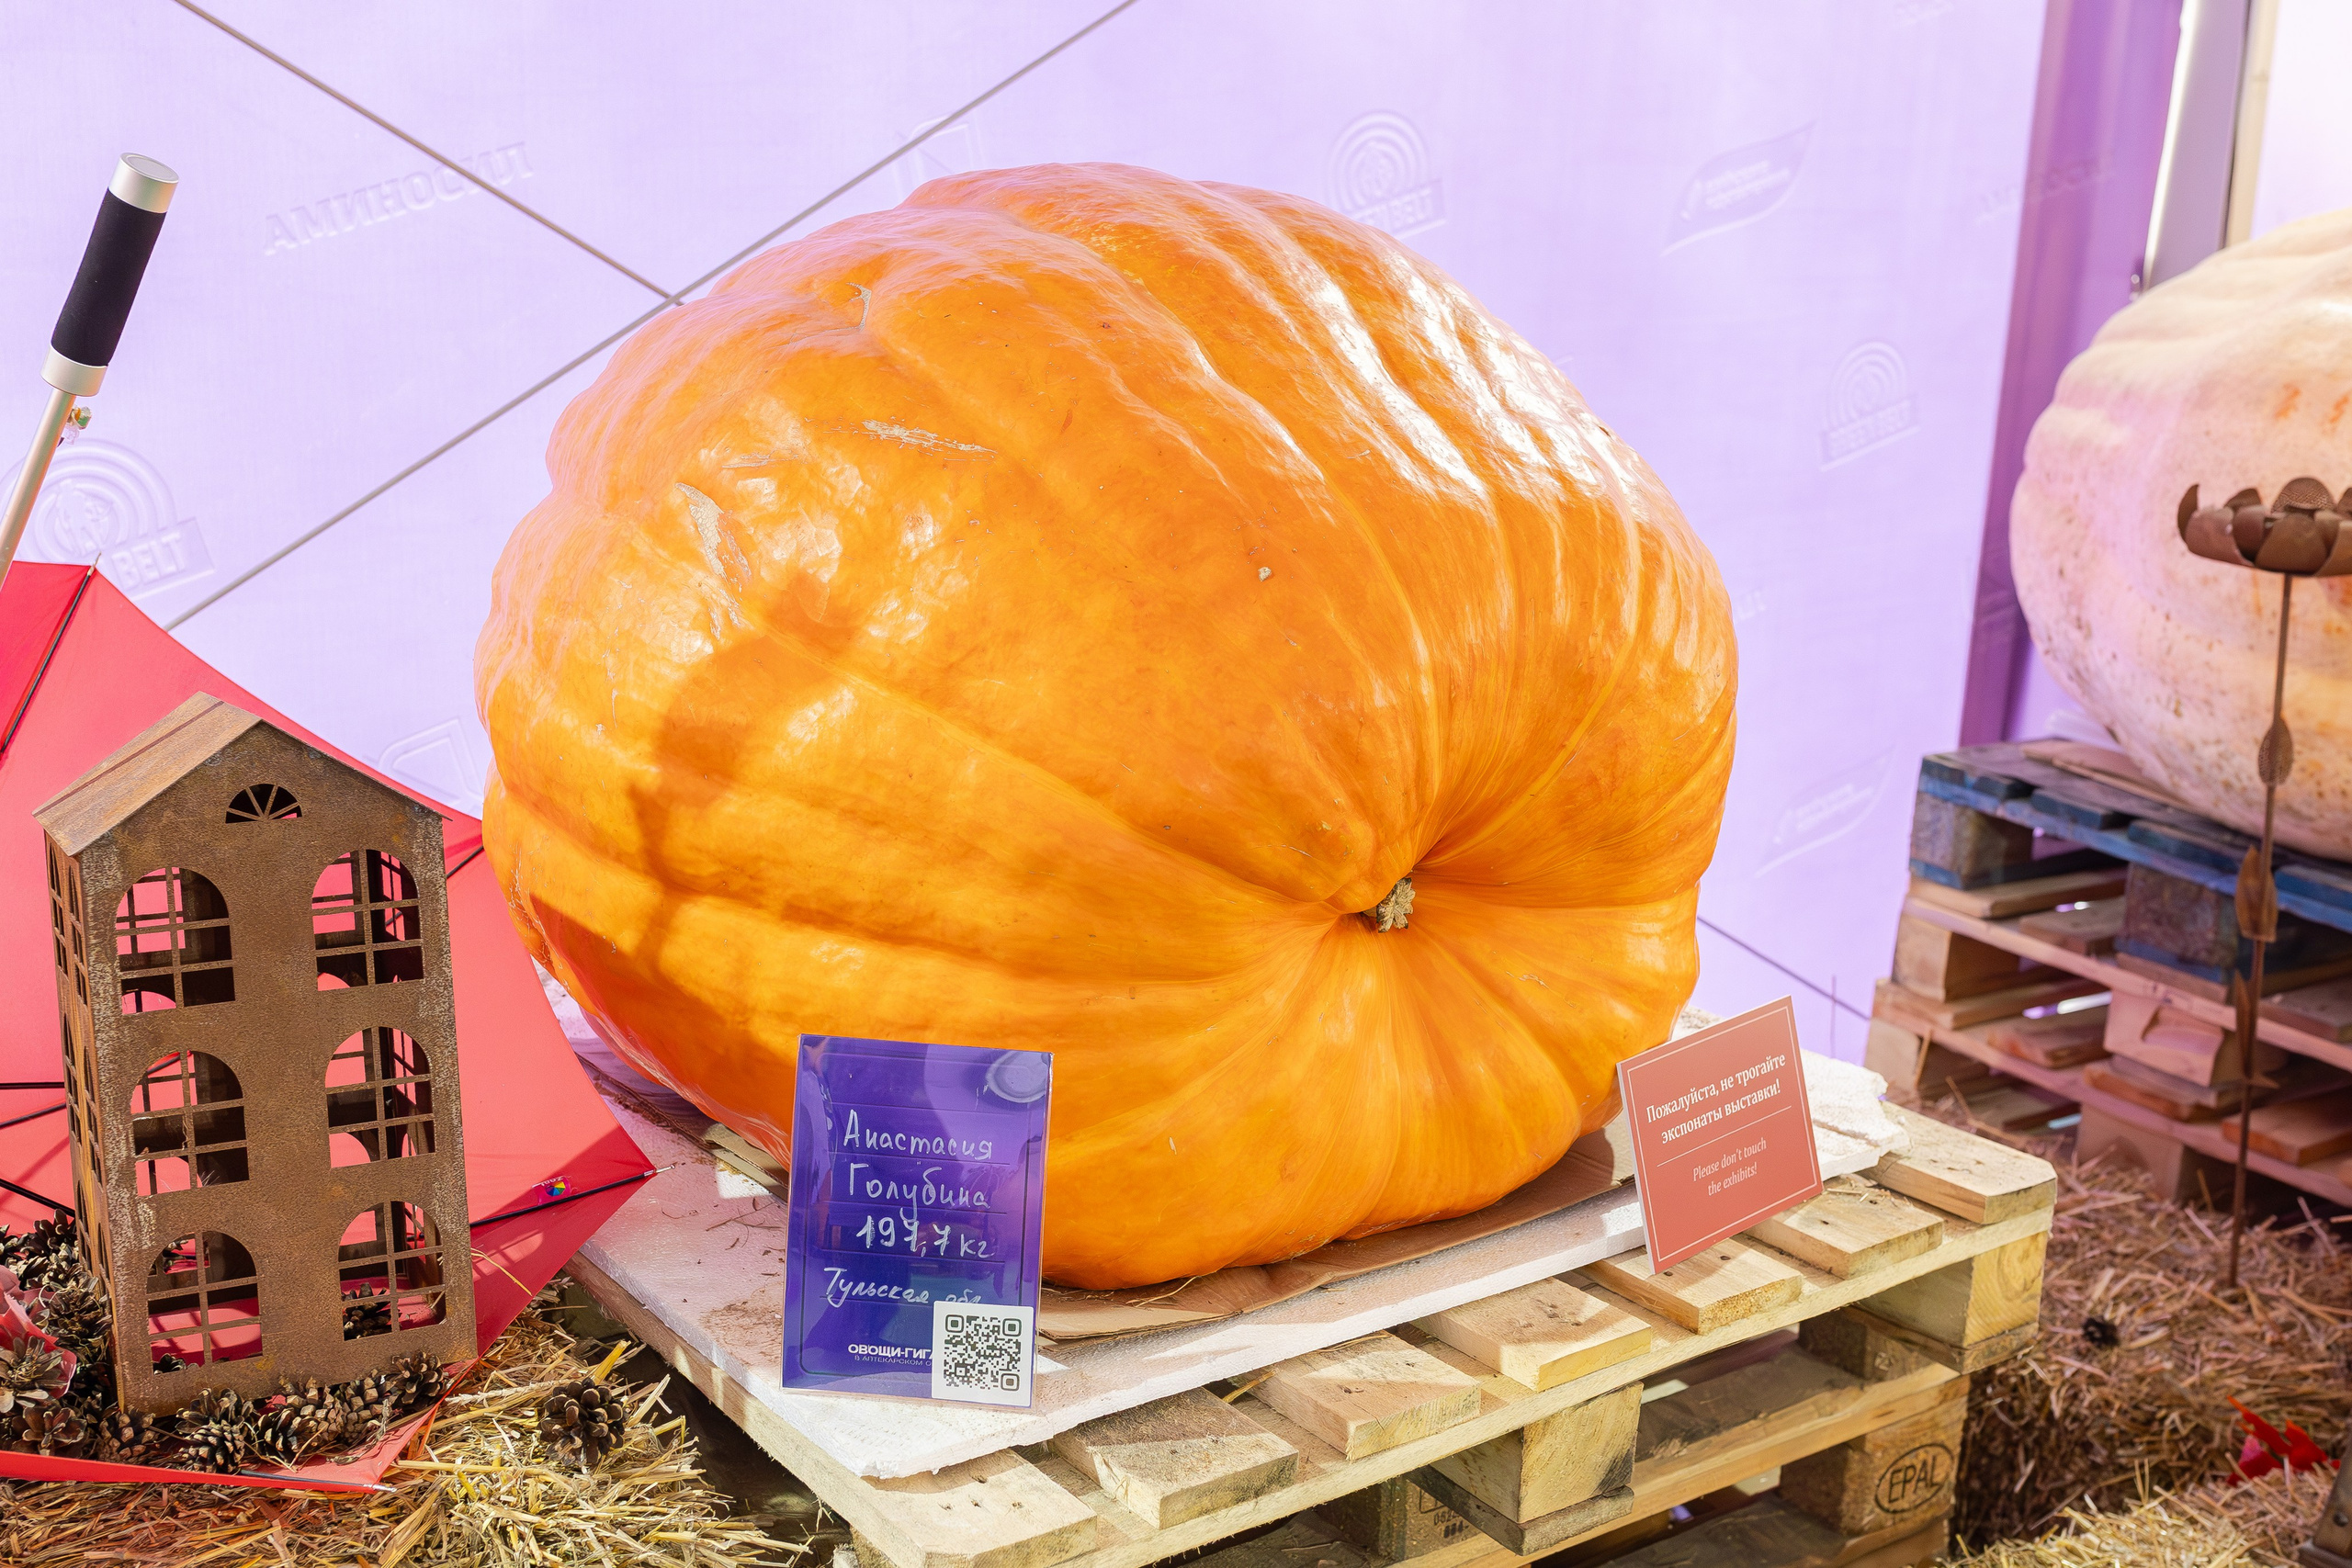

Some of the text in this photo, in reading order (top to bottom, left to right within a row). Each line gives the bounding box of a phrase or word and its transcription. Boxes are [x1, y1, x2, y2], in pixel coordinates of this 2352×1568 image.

[264, 141, 535, 256] АМИНОСИЛ
[111, 532, 185, 589] BELT
[1646, 1054, 1786, 1123] Пожалуйста, не трогайте
[1661, 1078, 1781, 1144] экспонаты выставки!
[843, 1109, 992, 1159] Анастасия
[1692, 1159, 1720, 1181] Please
[1744, 1137, 1767, 1158] touch
[849, 1163, 990, 1222] Голубина
[1707, 1162, 1758, 1196] the exhibits!
[856, 1215, 952, 1258] 197,7
[824, 1267, 930, 1308] Тульская
[862, 1356, 923, 1366] АПТЕКАРСКОМ
[1888, 1454, 1941, 1504] EPAL
